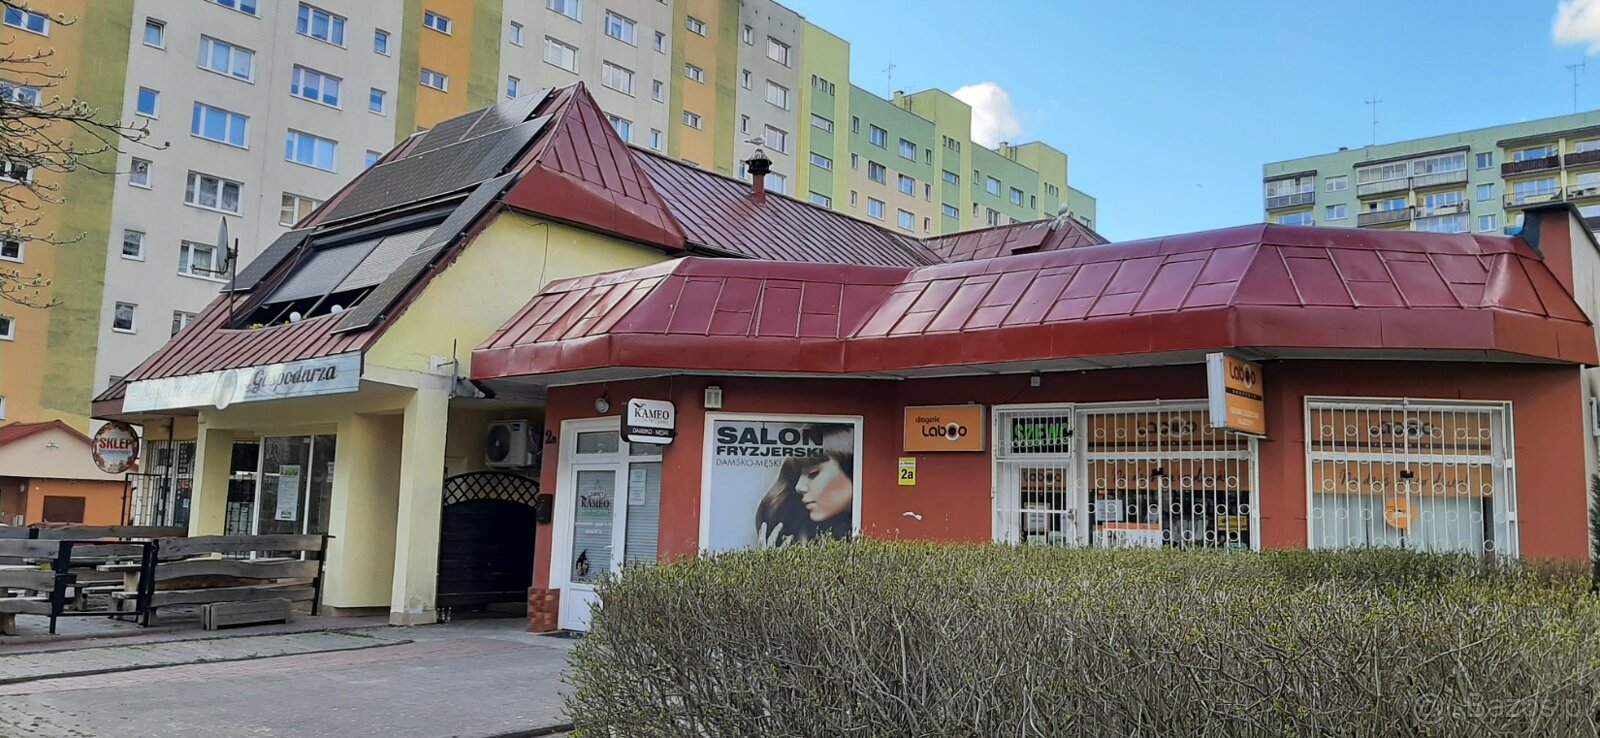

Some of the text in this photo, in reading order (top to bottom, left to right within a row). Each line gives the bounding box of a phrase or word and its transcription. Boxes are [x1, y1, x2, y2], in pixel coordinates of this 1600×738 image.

[252, 365, 337, 393] Gospodarza
[634, 407, 670, 420] KAMEO
[915, 416, 940, 424] drogerie
[717, 427, 824, 446] SALON
[99, 437, 132, 450] SKLEP
[716, 446, 825, 457] FRYZJERSKI
[901, 468, 913, 479] 2a
